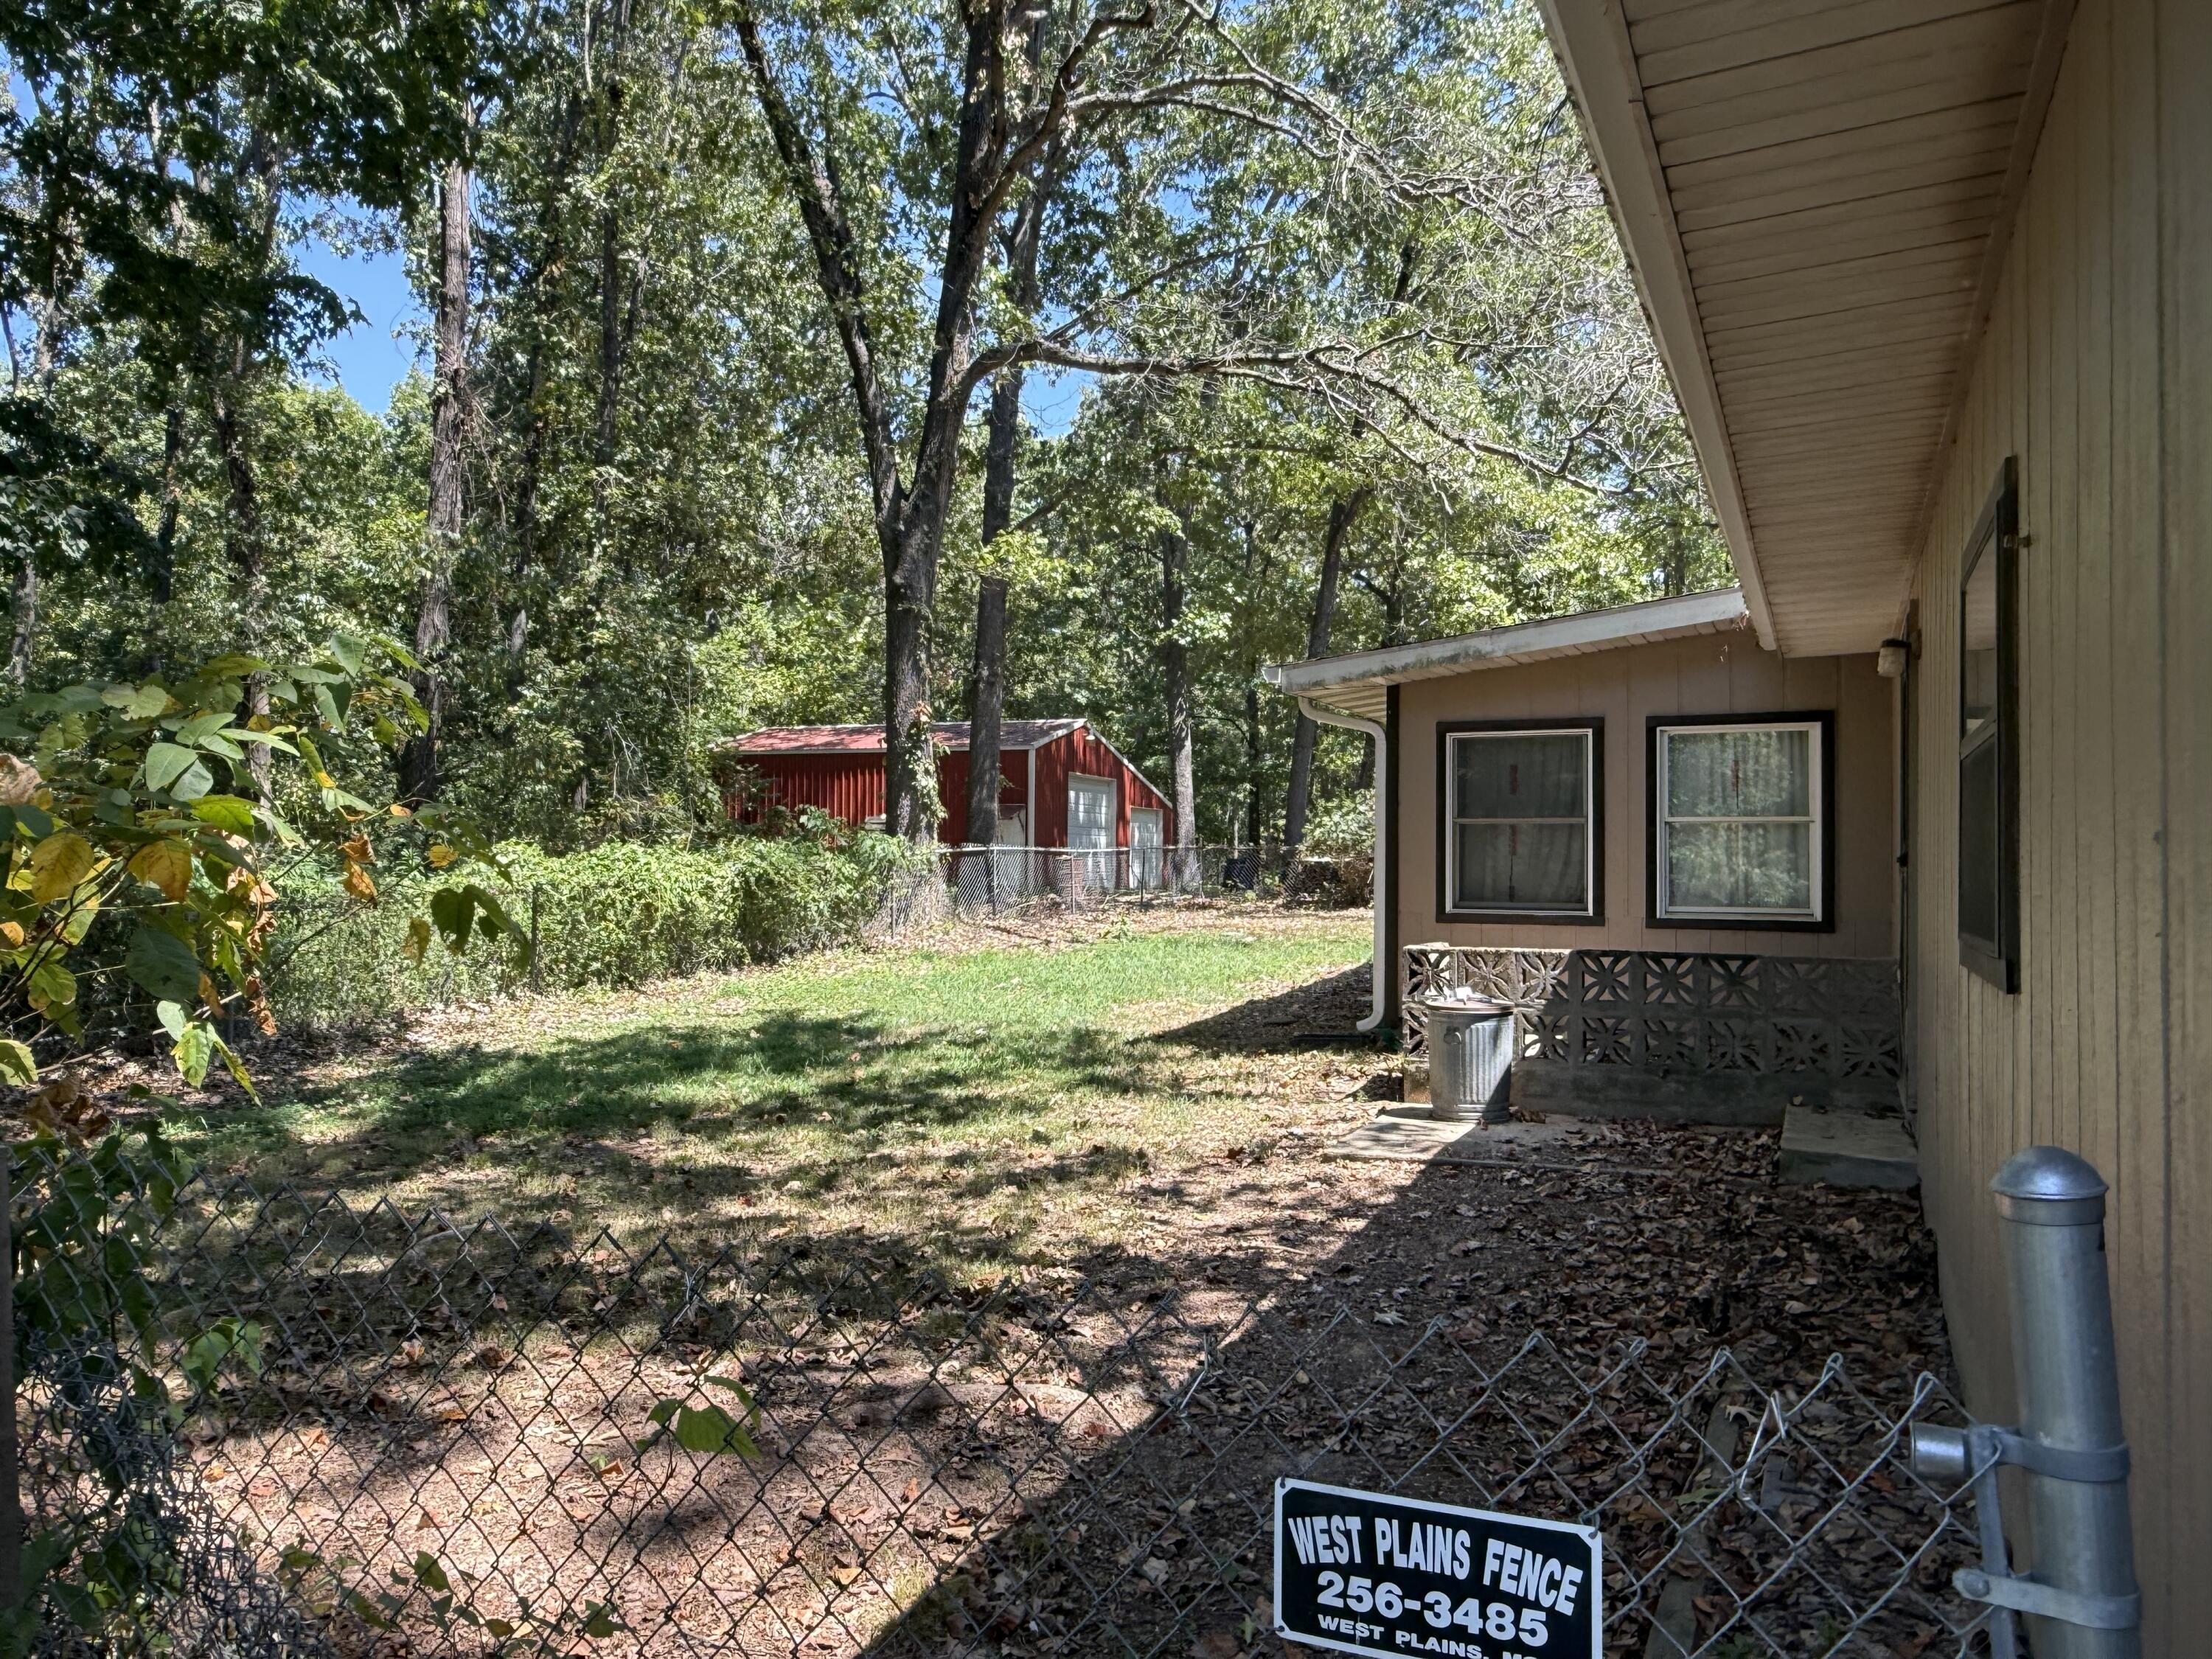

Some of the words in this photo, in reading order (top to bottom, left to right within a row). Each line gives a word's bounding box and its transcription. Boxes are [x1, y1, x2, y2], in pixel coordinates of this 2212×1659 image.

[1287, 1514, 1362, 1565] WEST
[1374, 1517, 1471, 1580] PLAINS
[1483, 1538, 1584, 1616] FENCE
[1317, 1571, 1548, 1647] 256-3485
[1318, 1614, 1384, 1640] WEST
